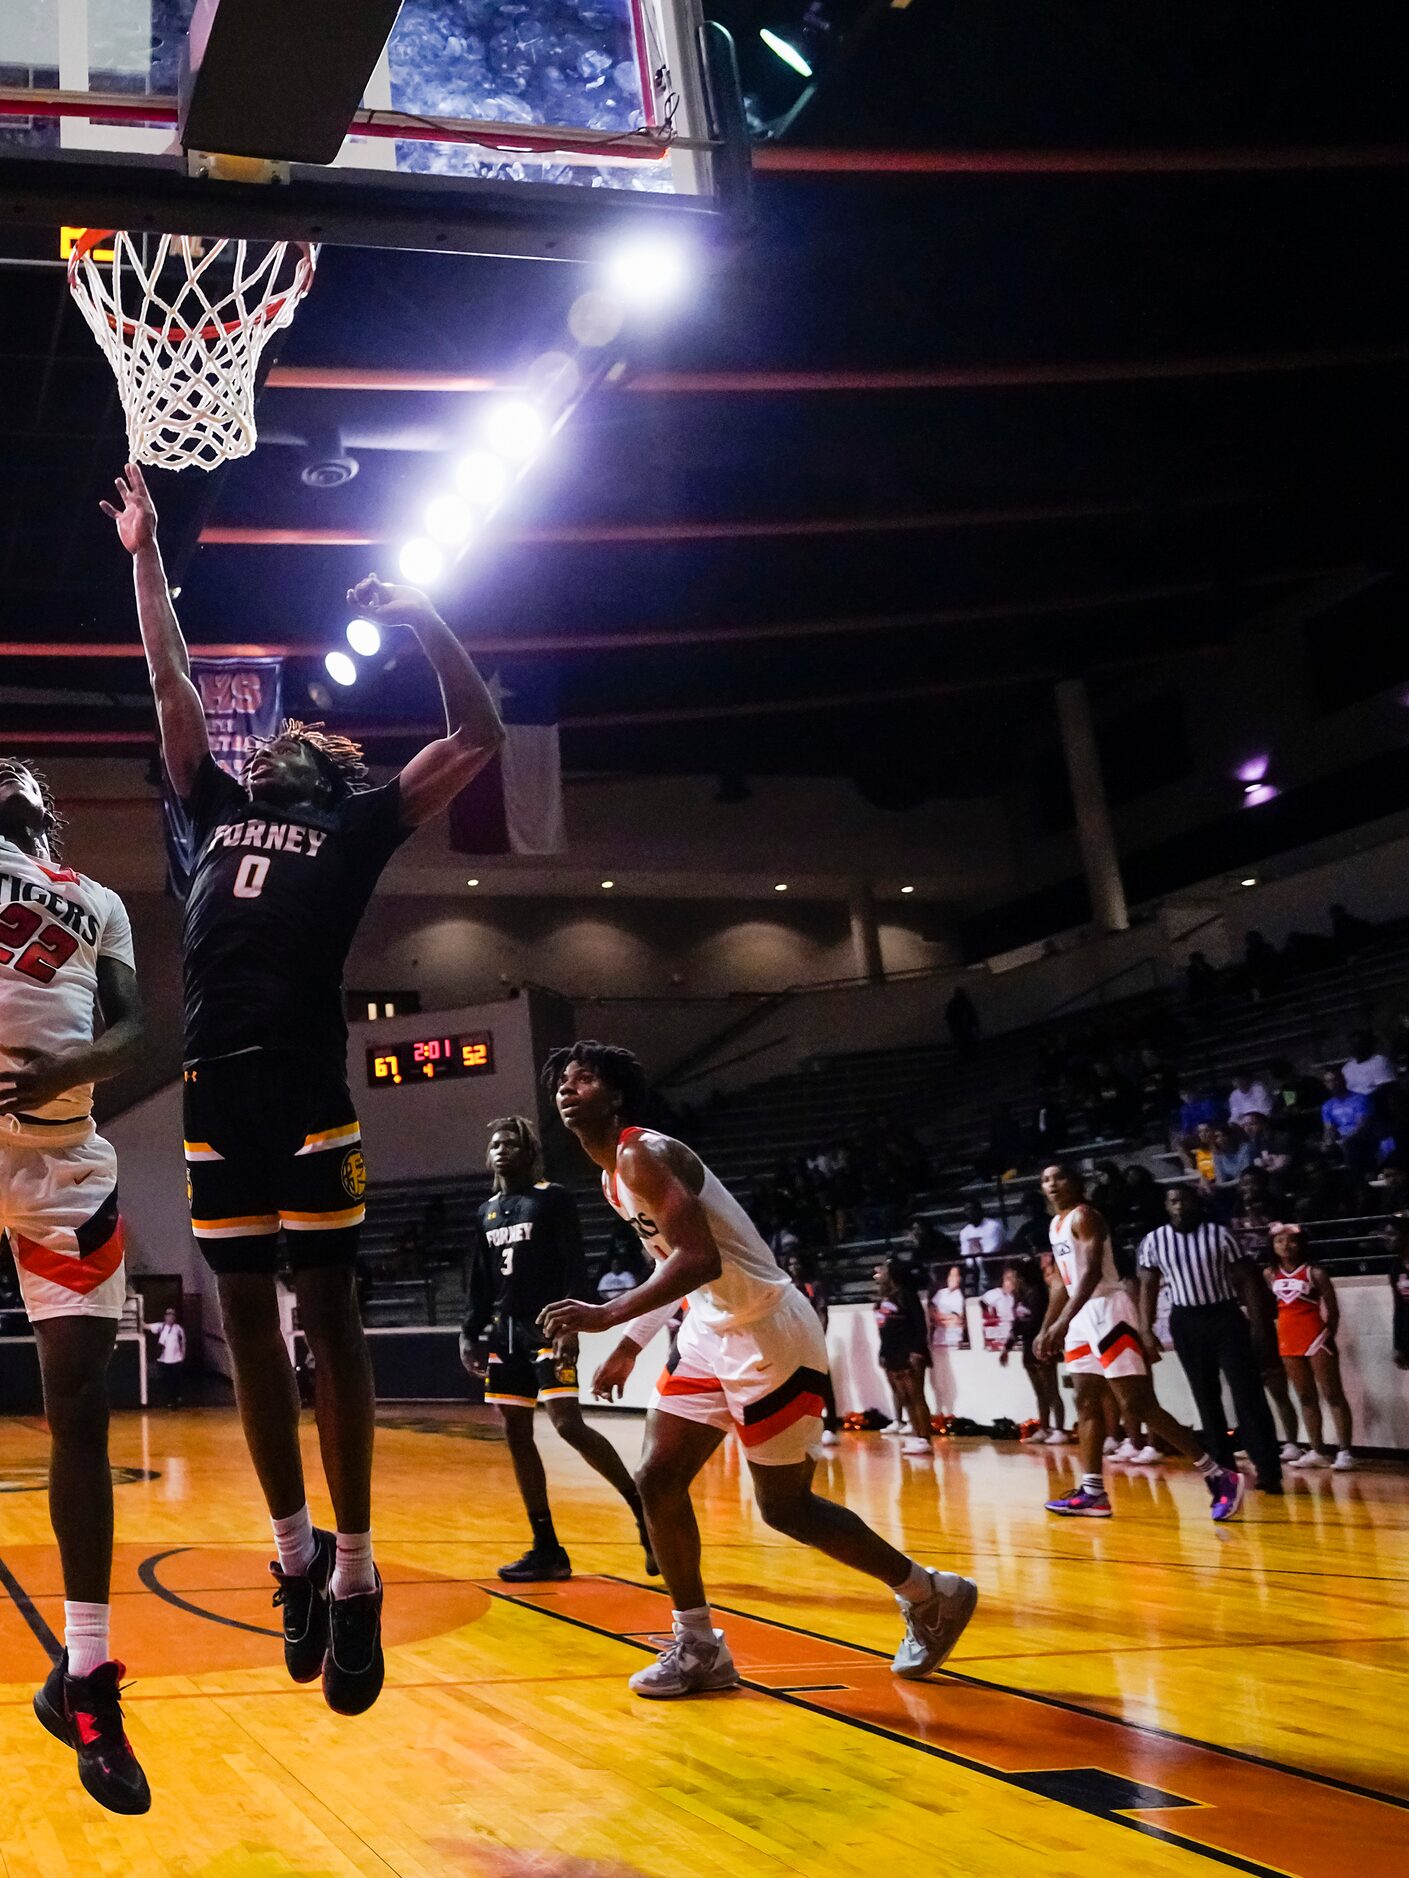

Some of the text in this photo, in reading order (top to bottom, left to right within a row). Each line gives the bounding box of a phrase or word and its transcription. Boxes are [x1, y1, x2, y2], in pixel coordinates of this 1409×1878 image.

[197, 673, 261, 714] HS
[207, 819, 328, 858] FORNEY
[232, 854, 271, 899] 0
[413, 1039, 451, 1062] 2:01
[462, 1043, 488, 1066] 52
[374, 1055, 399, 1078] 67
[485, 1221, 534, 1248] FORNEY
[500, 1247, 515, 1276] 3
